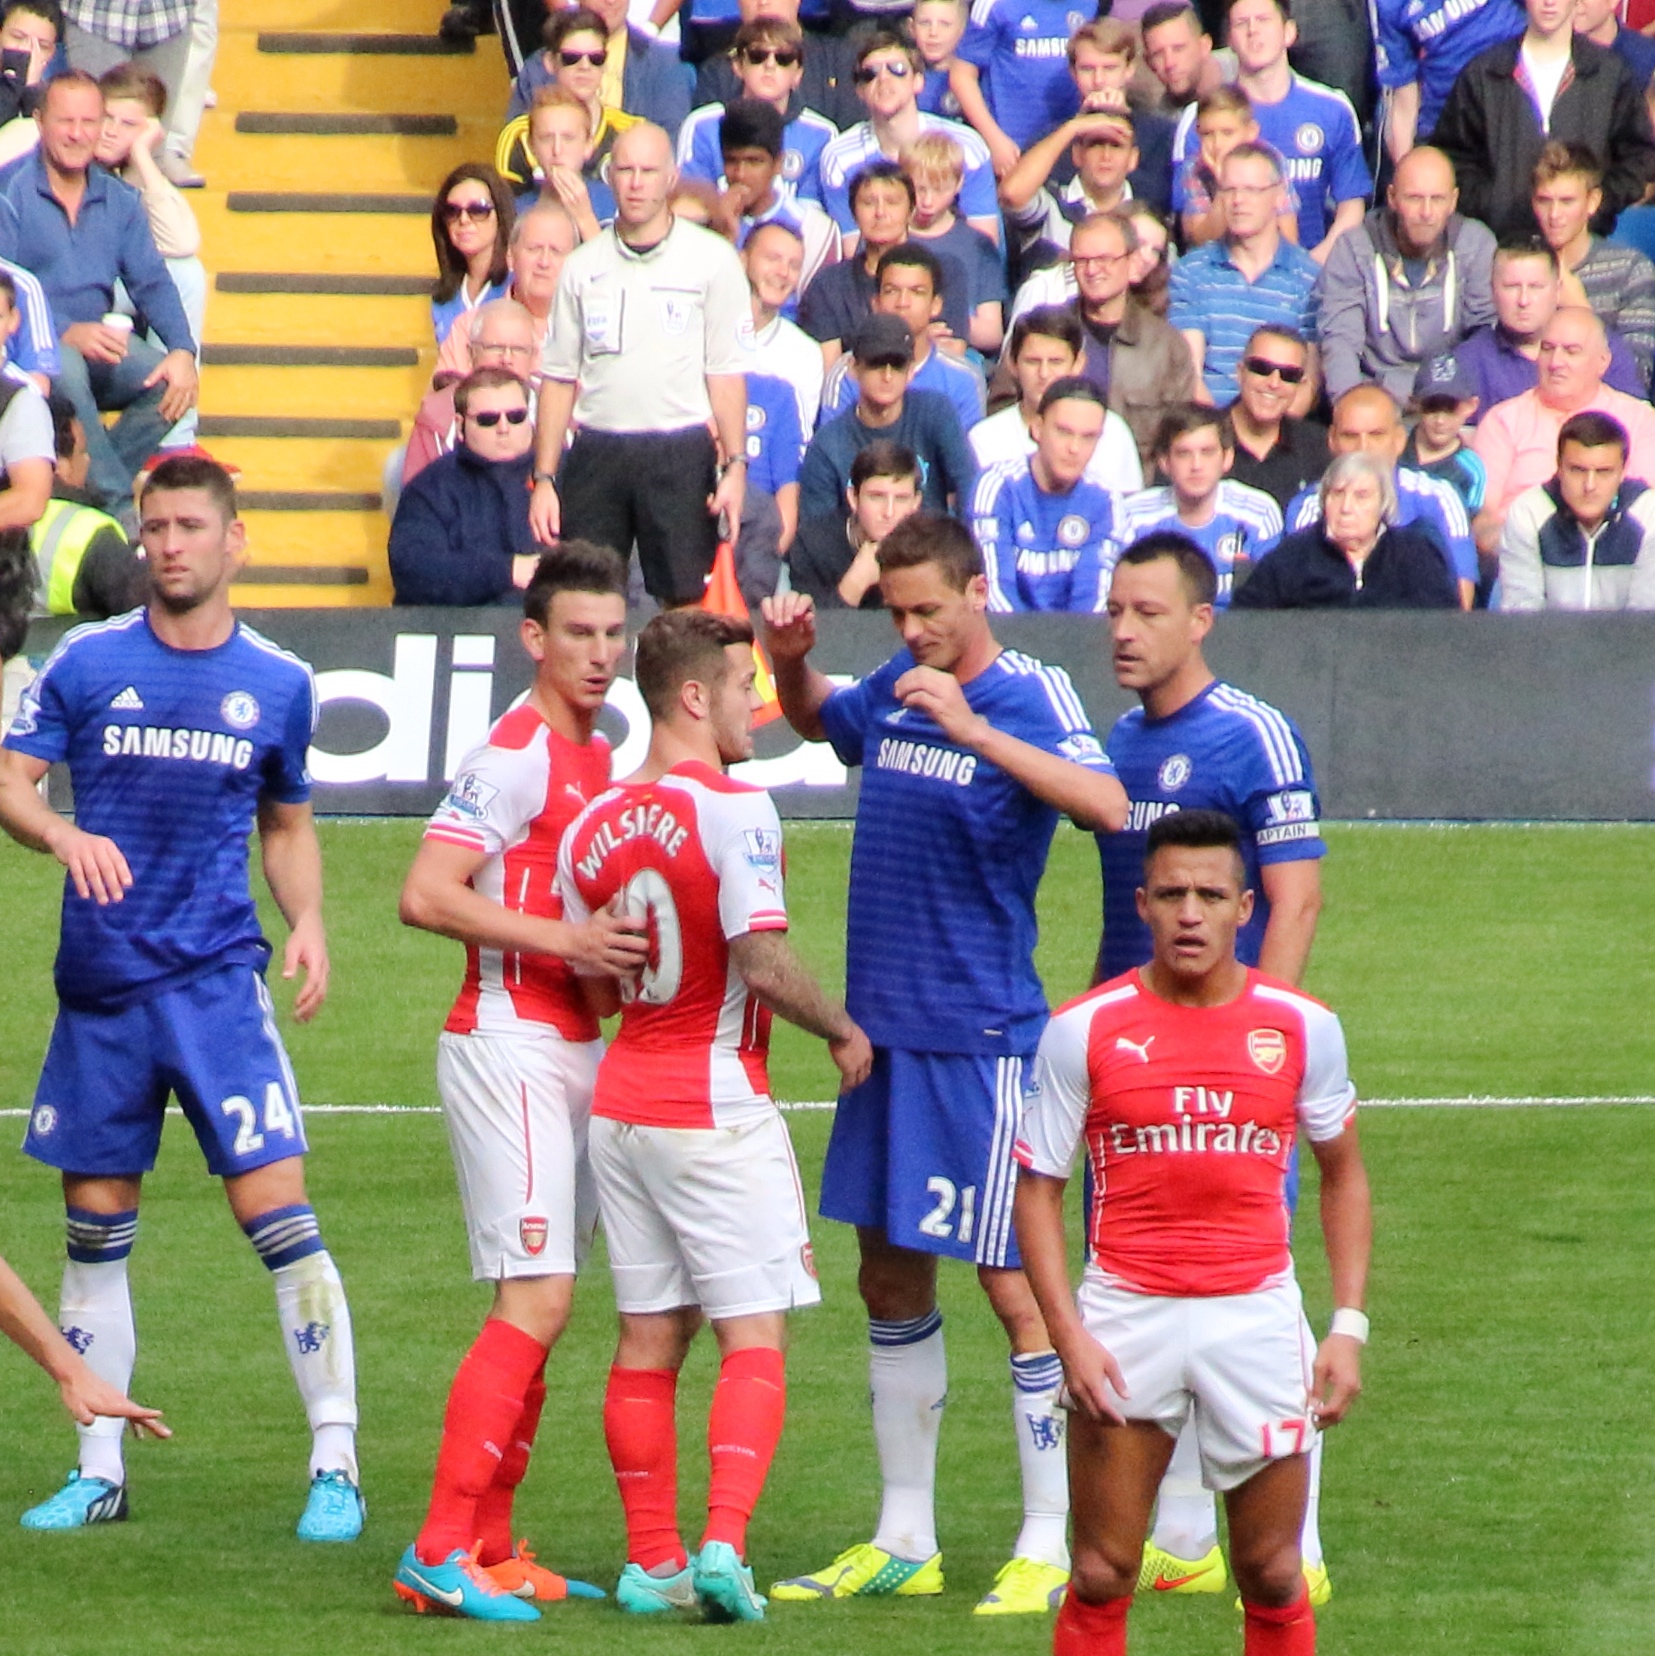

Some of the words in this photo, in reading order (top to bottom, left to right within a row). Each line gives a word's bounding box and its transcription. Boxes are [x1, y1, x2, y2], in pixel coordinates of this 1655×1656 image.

[103, 724, 253, 770] SAMSUNG
[877, 738, 987, 786] SAMSUNG
[1259, 824, 1306, 846] APTAIN
[221, 1081, 294, 1154] 24
[1174, 1086, 1234, 1127] Fly
[1111, 1114, 1281, 1156] Emirates
[919, 1176, 976, 1243] 21
[1261, 1418, 1305, 1458] 17
